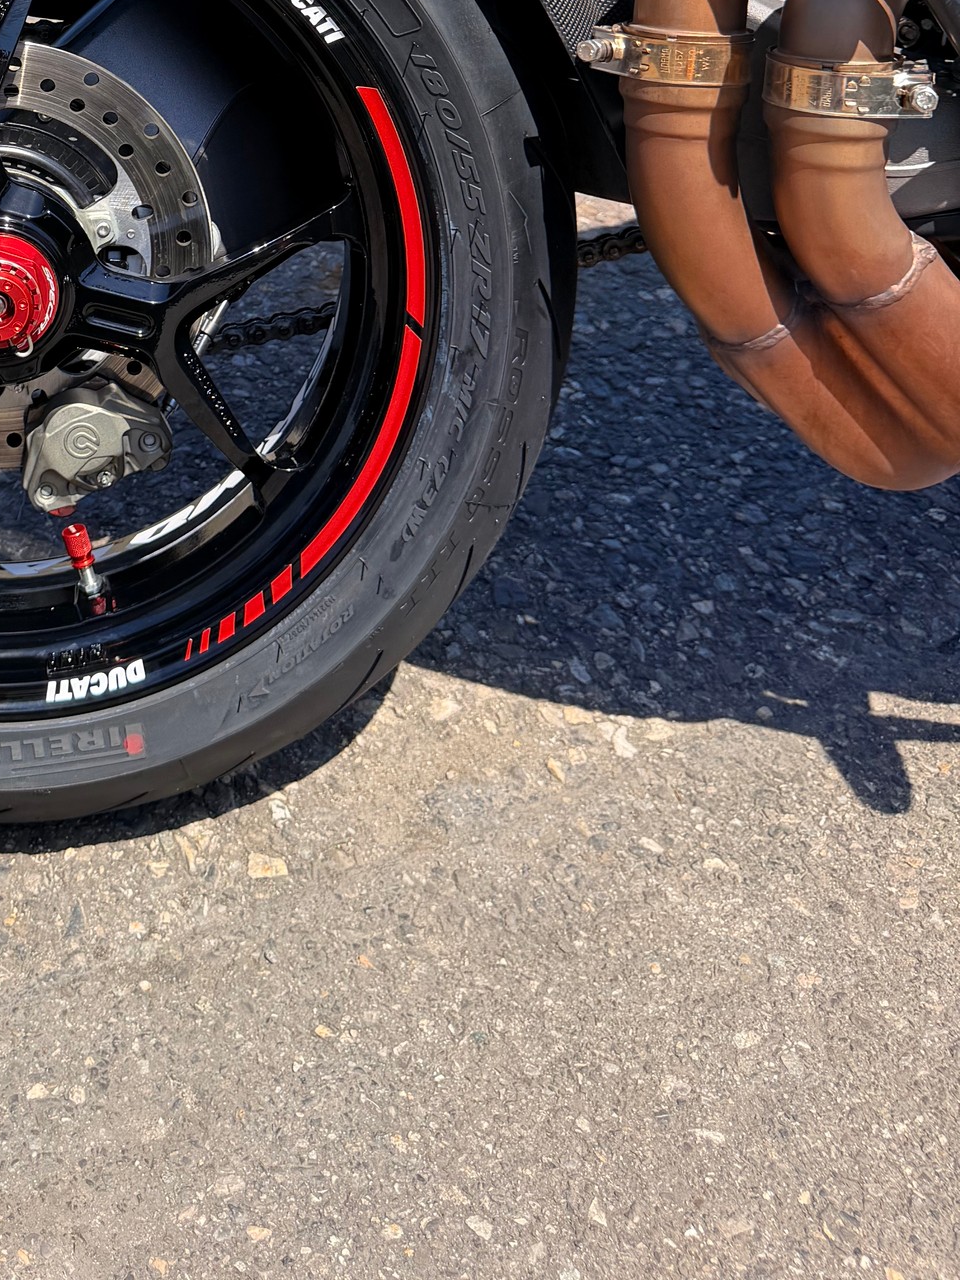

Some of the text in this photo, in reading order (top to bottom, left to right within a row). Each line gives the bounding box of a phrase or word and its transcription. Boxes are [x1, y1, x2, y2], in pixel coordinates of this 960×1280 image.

[409, 44, 485, 217] 180/55
[465, 326, 530, 523] ROSSO
[46, 659, 146, 703] DUCATI
[263, 604, 354, 686] ROTATION
